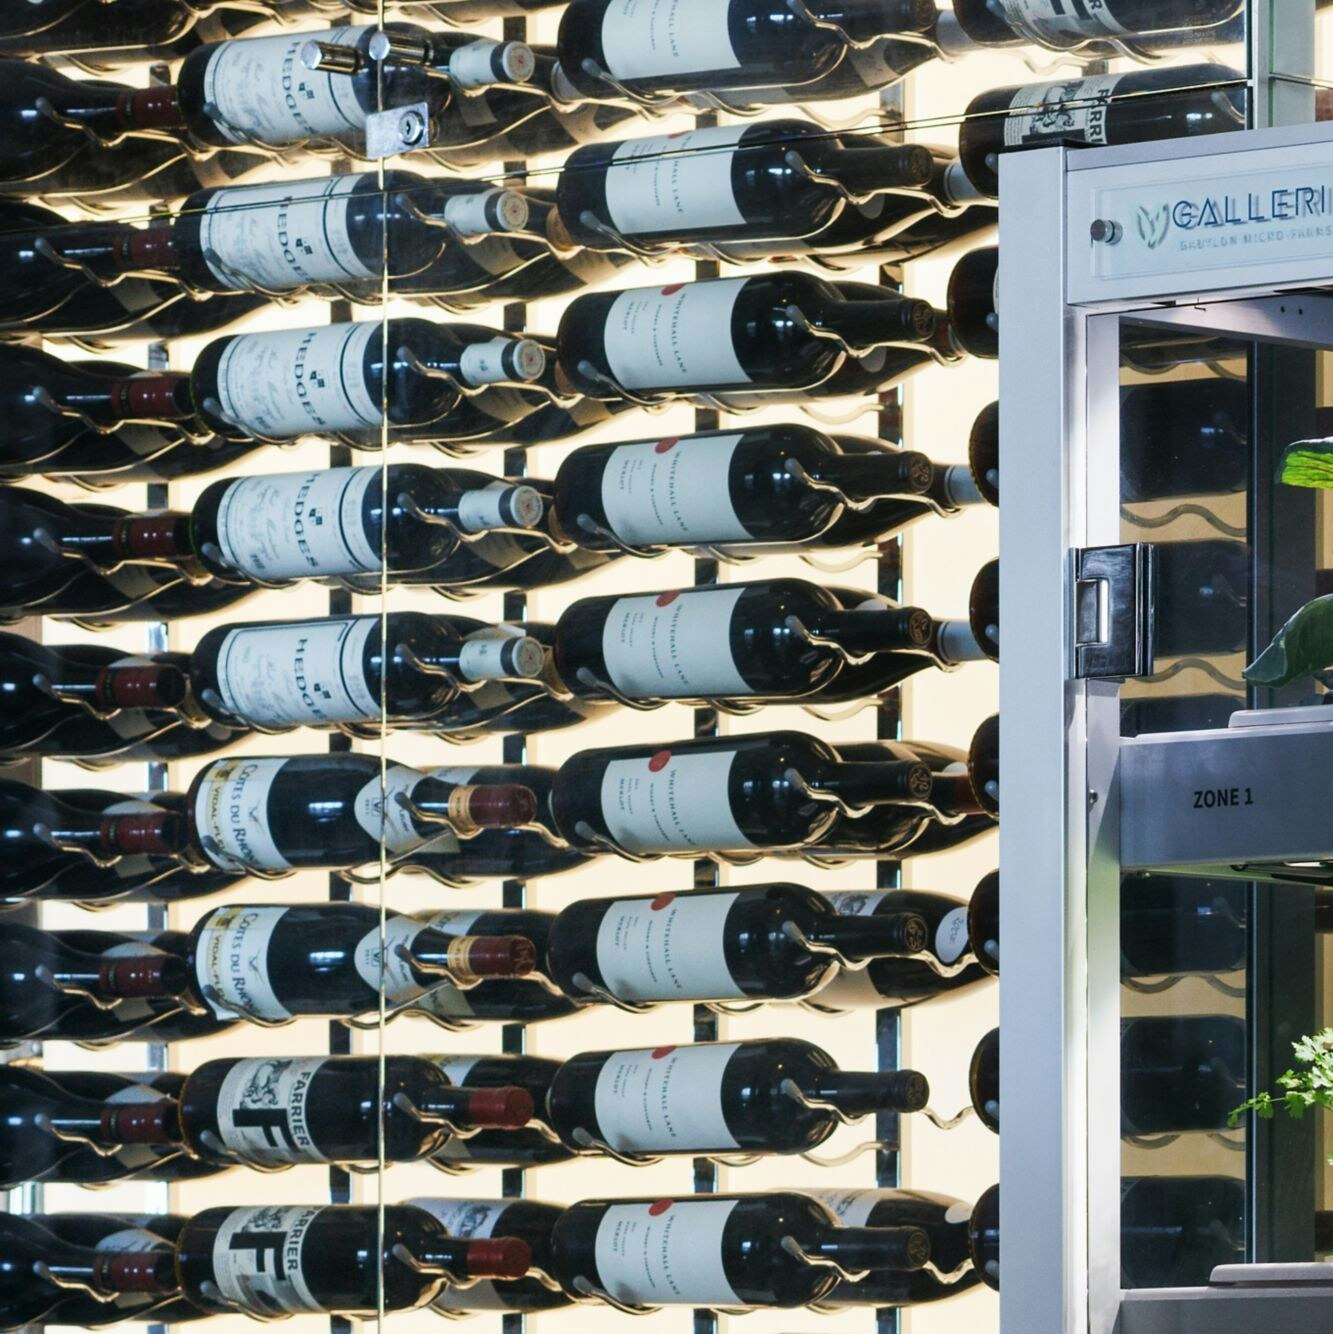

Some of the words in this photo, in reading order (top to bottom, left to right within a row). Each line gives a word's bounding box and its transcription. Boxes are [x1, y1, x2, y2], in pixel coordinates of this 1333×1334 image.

[282, 41, 319, 135] HEDGES
[672, 189, 683, 213] LANE
[1172, 185, 1325, 228] GALLERI
[671, 293, 686, 349] WHITEHALL
[294, 331, 326, 425] HEDGES
[674, 350, 687, 373] LANE
[669, 451, 682, 506] WHITEHALL
[293, 473, 319, 567] HEDGES
[674, 510, 688, 532] LANE
[669, 604, 683, 661] WHITEHALL
[295, 638, 327, 719] HEDGES
[674, 664, 689, 685] LANE
[230, 806, 240, 824] DU
[668, 770, 680, 826] WHITEHALL
[680, 828, 696, 846] LANE
[1193, 788, 1239, 808] ZONE
[1244, 787, 1254, 805] 1
[230, 954, 240, 973] DU
[664, 908, 677, 964] WHITEHALL
[668, 967, 682, 988] LANE
[290, 1072, 312, 1146] FARRIER
[661, 1057, 678, 1112] WHITEHALL
[663, 1114, 676, 1137] LANE
[662, 1215, 675, 1271] WHITEHALL
[666, 1274, 680, 1295] LANE
